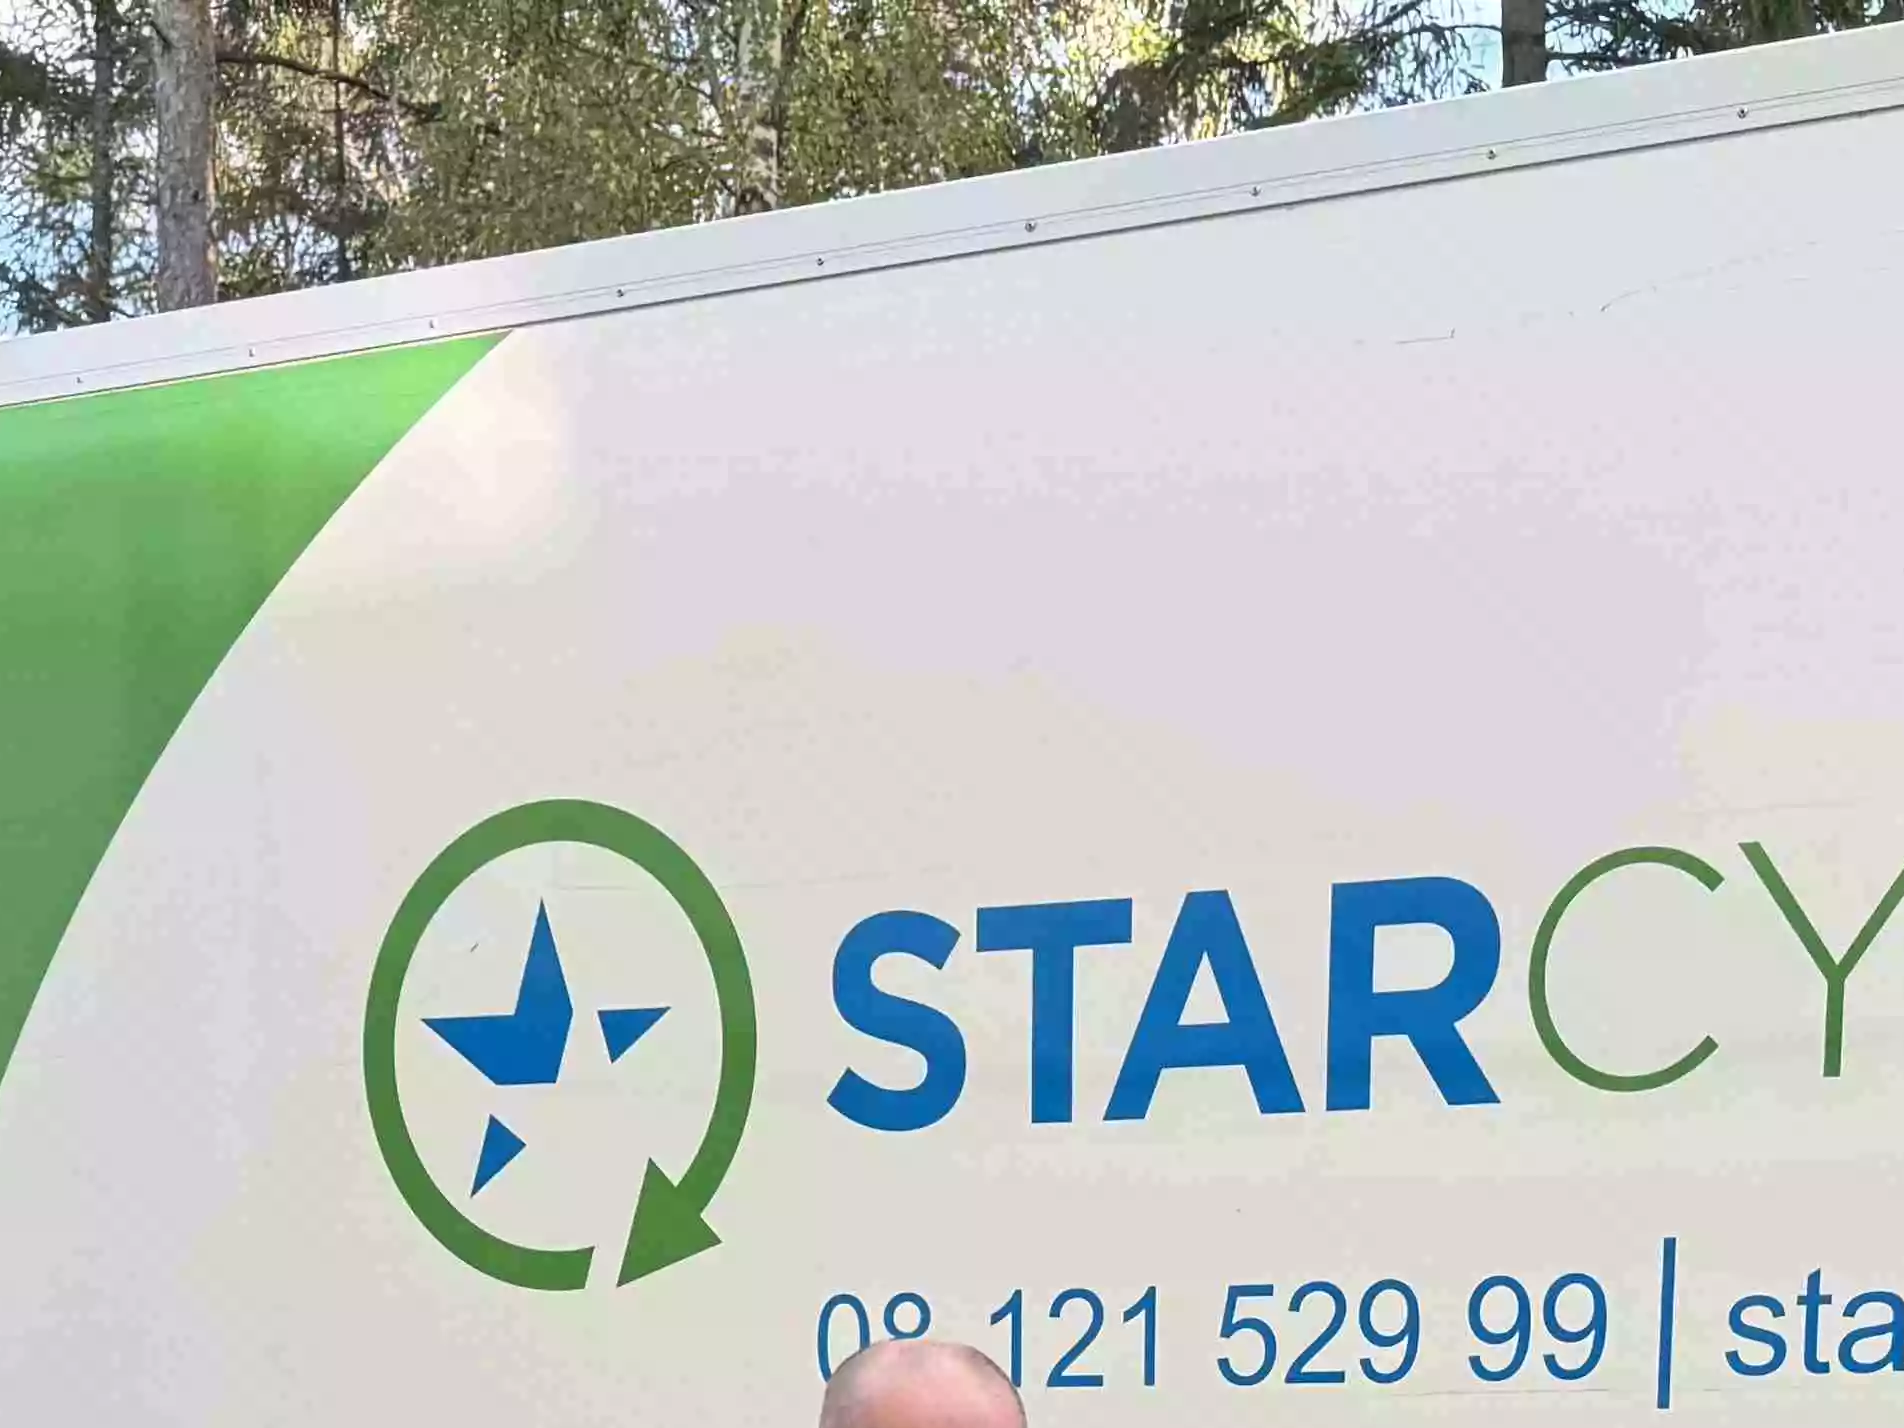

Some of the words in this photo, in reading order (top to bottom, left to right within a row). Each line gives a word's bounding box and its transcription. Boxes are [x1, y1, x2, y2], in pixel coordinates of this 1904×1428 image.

[989, 1286, 1159, 1388] 121
[1216, 1279, 1422, 1387] 529
[1466, 1272, 1609, 1384] 99
